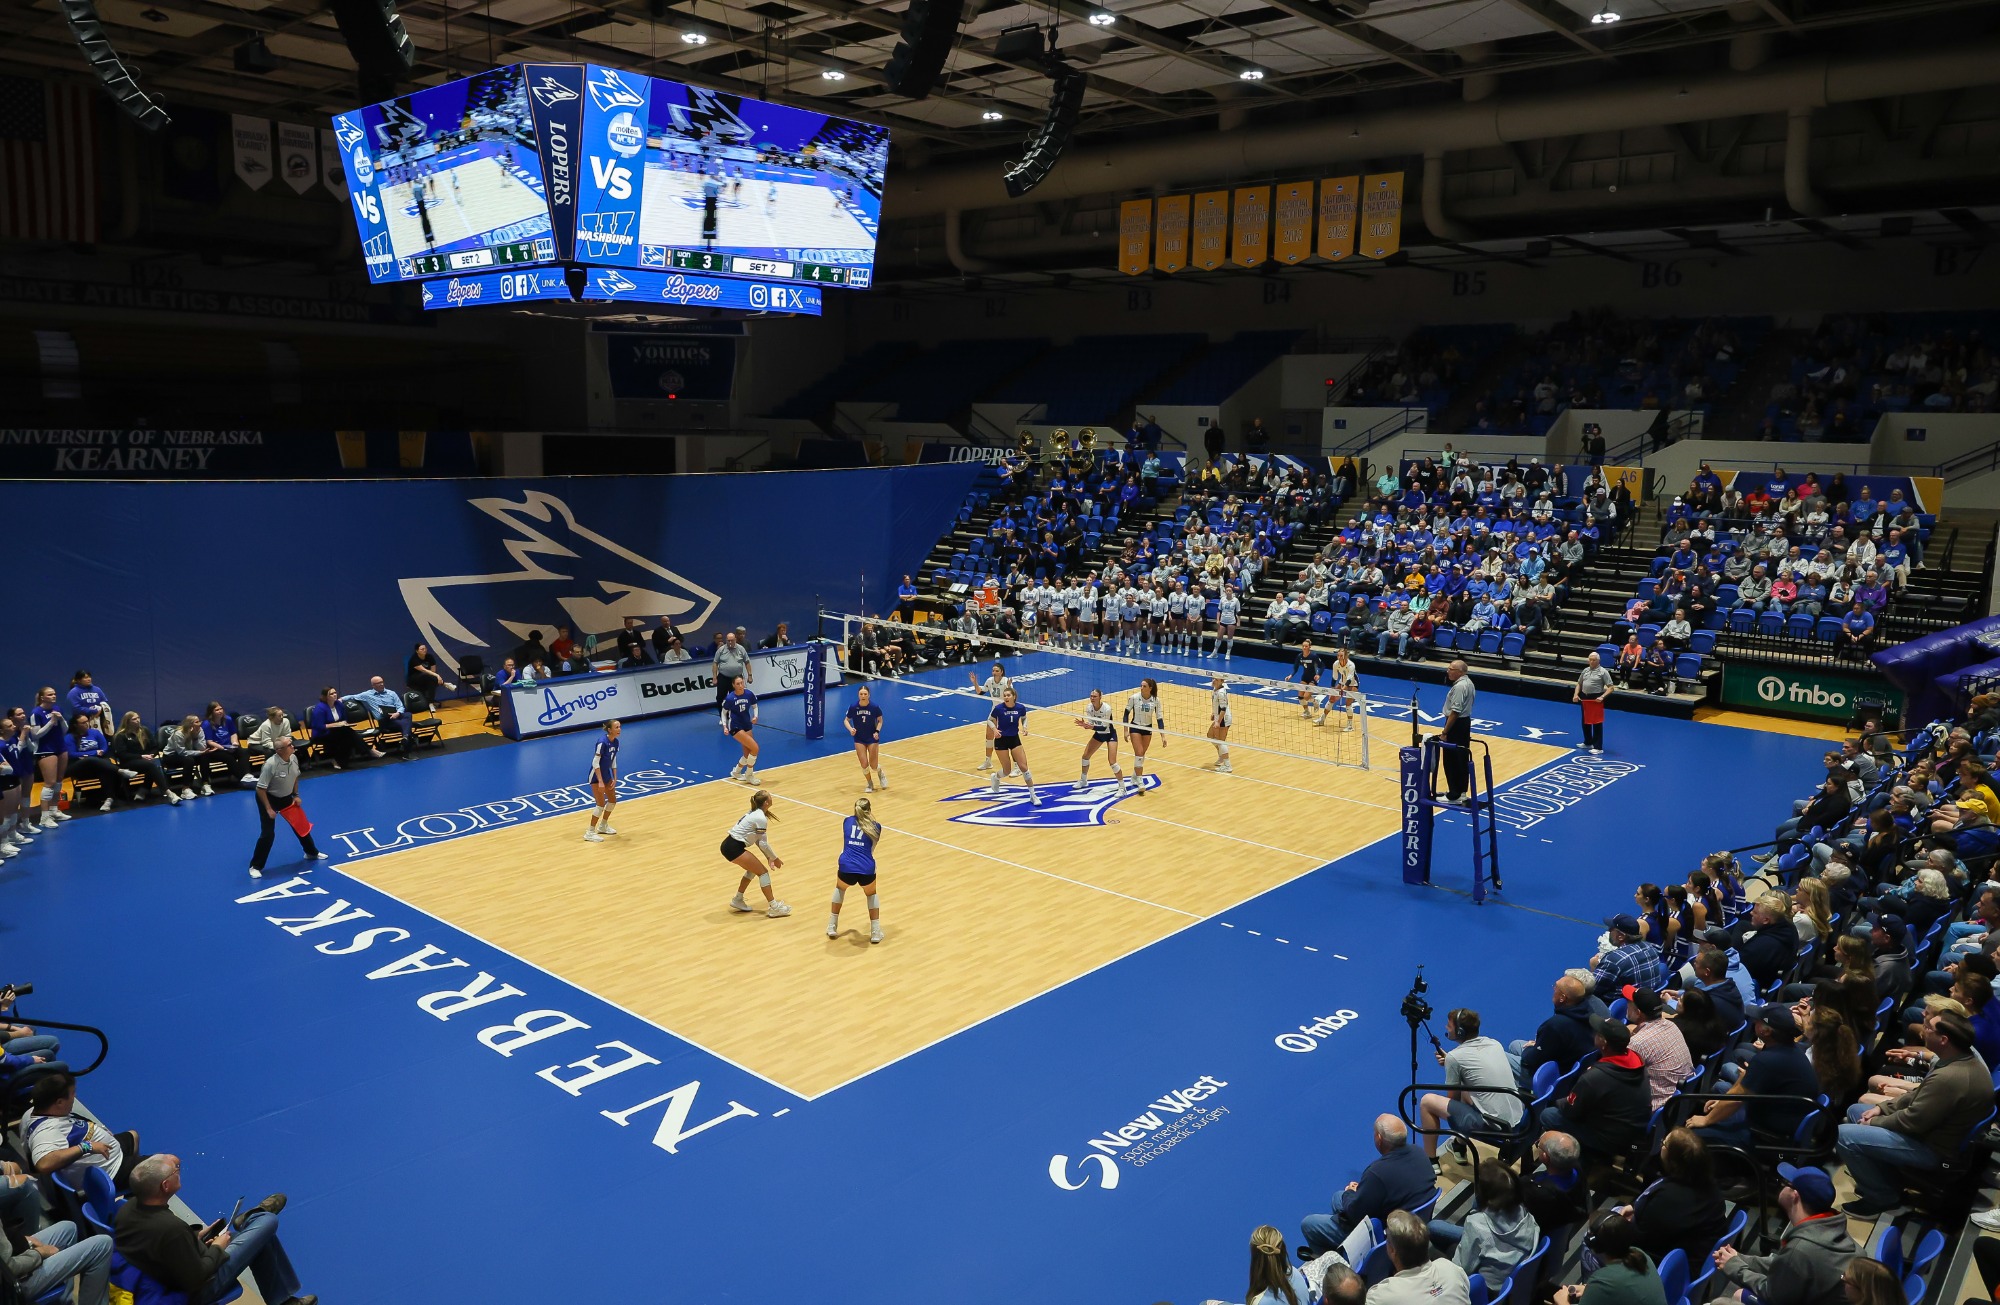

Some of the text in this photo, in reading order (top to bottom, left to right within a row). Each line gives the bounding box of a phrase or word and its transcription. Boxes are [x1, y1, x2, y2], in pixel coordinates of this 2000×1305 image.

[237, 140, 267, 152] KEARNEY
[549, 119, 571, 206] LOPERS
[589, 155, 633, 200] VS
[353, 189, 381, 225] VS
[576, 229, 635, 246] WASHBURN
[433, 257, 440, 271] 3
[461, 253, 481, 265] SET 2
[505, 247, 513, 262] 4
[702, 254, 712, 269] 3
[1933, 243, 1987, 277] B7
[749, 262, 777, 274] SET 2
[812, 269, 820, 281] 4
[1641, 261, 1683, 289] B6
[447, 277, 482, 308] Lopers
[662, 273, 720, 305] Lopers
[1263, 282, 1292, 305] B4
[1452, 270, 1488, 296] B5
[228, 294, 370, 321] ASSOCIATION
[1127, 290, 1152, 312] B3
[632, 345, 711, 361] younes
[129, 429, 156, 445] OF
[163, 429, 264, 445] NEBRASKA
[54, 447, 216, 472] KEARNEY
[949, 446, 1015, 466] LOPERS
[1620, 469, 1638, 484] A6
[766, 655, 798, 673] Kearney
[641, 675, 717, 699] Buckle
[806, 660, 815, 727] LOPERS
[1788, 681, 1847, 709] fnbo
[538, 685, 618, 726] Amigos
[739, 704, 746, 713] 15
[850, 824, 864, 840] 17
[1404, 772, 1419, 867] LOPERS
[234, 876, 759, 1155] NEBRASKA
[1299, 1009, 1359, 1039] fnbo
[1087, 1075, 1229, 1156] New West
[1191, 1105, 1231, 1130] surgery
[1120, 1106, 1208, 1162] sports medicine &
